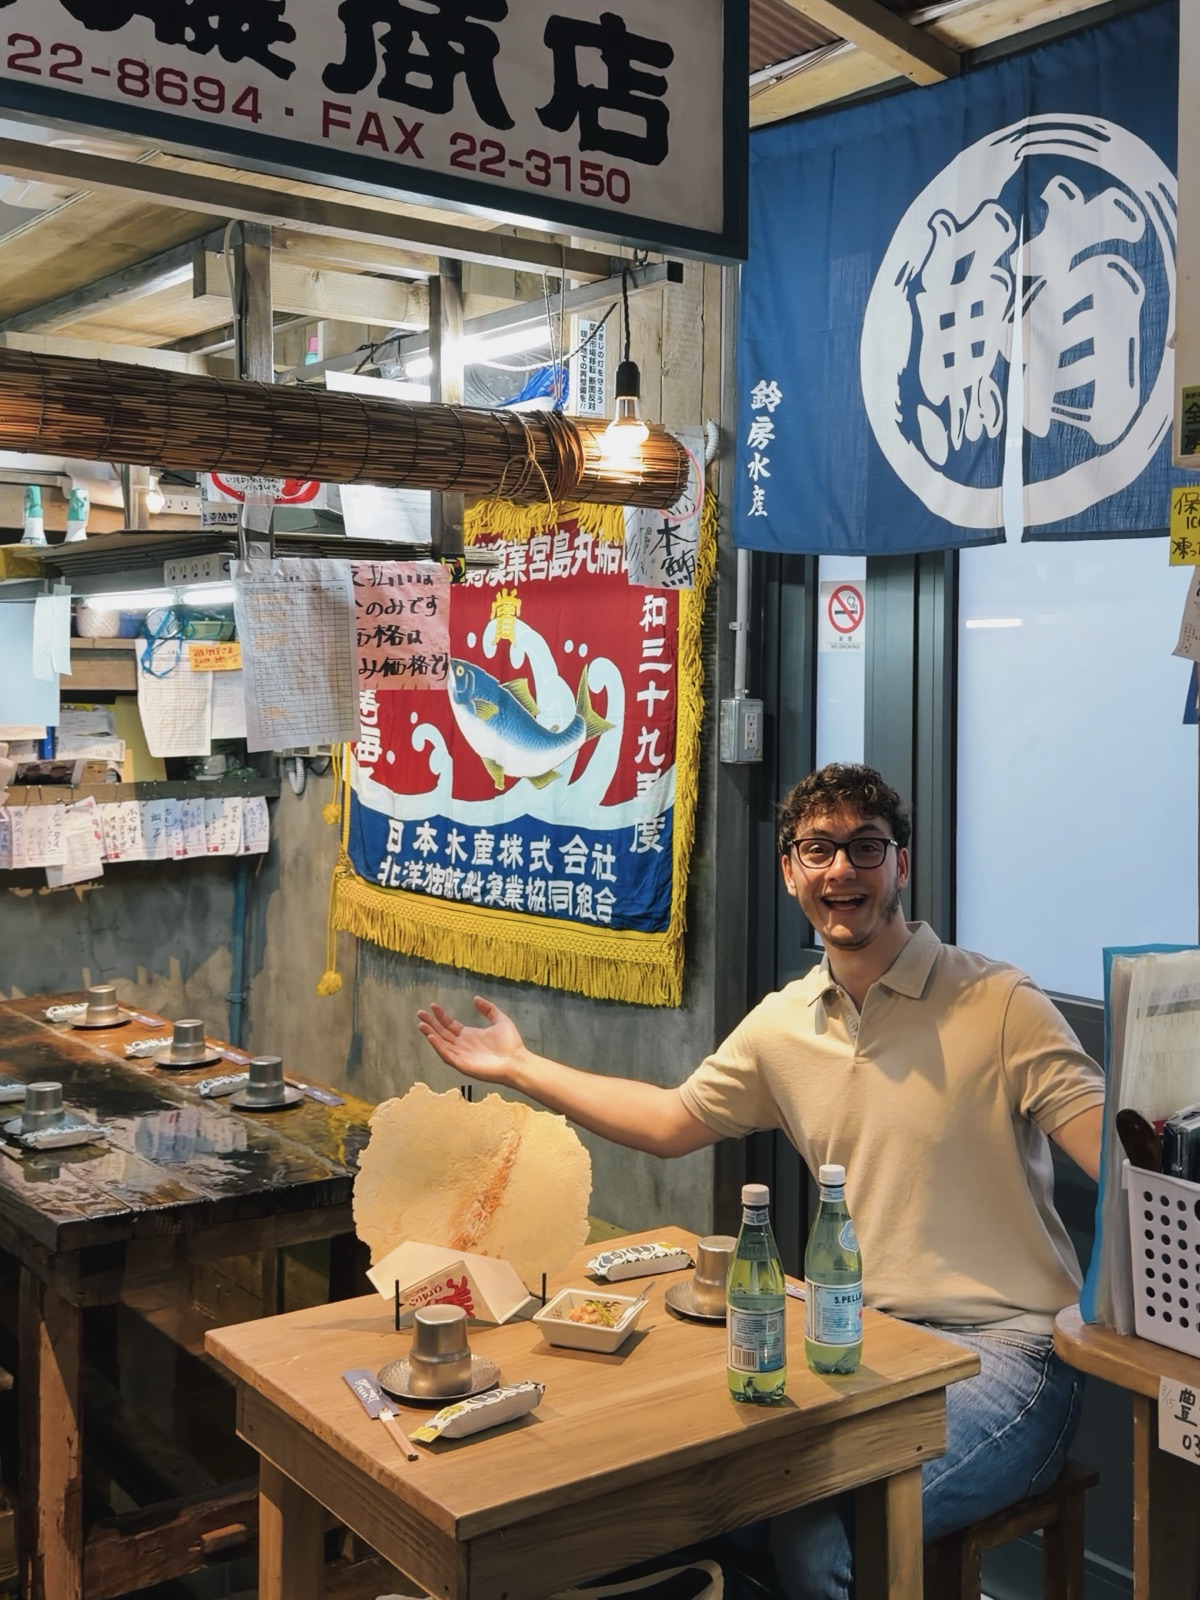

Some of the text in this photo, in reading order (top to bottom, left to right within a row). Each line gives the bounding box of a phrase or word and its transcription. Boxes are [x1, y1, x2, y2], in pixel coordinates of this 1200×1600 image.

[7, 32, 632, 204] 22-8694 FAX 22-3150
[355, 594, 439, 619] のみです
[386, 820, 618, 884] 日本水産株式会社
